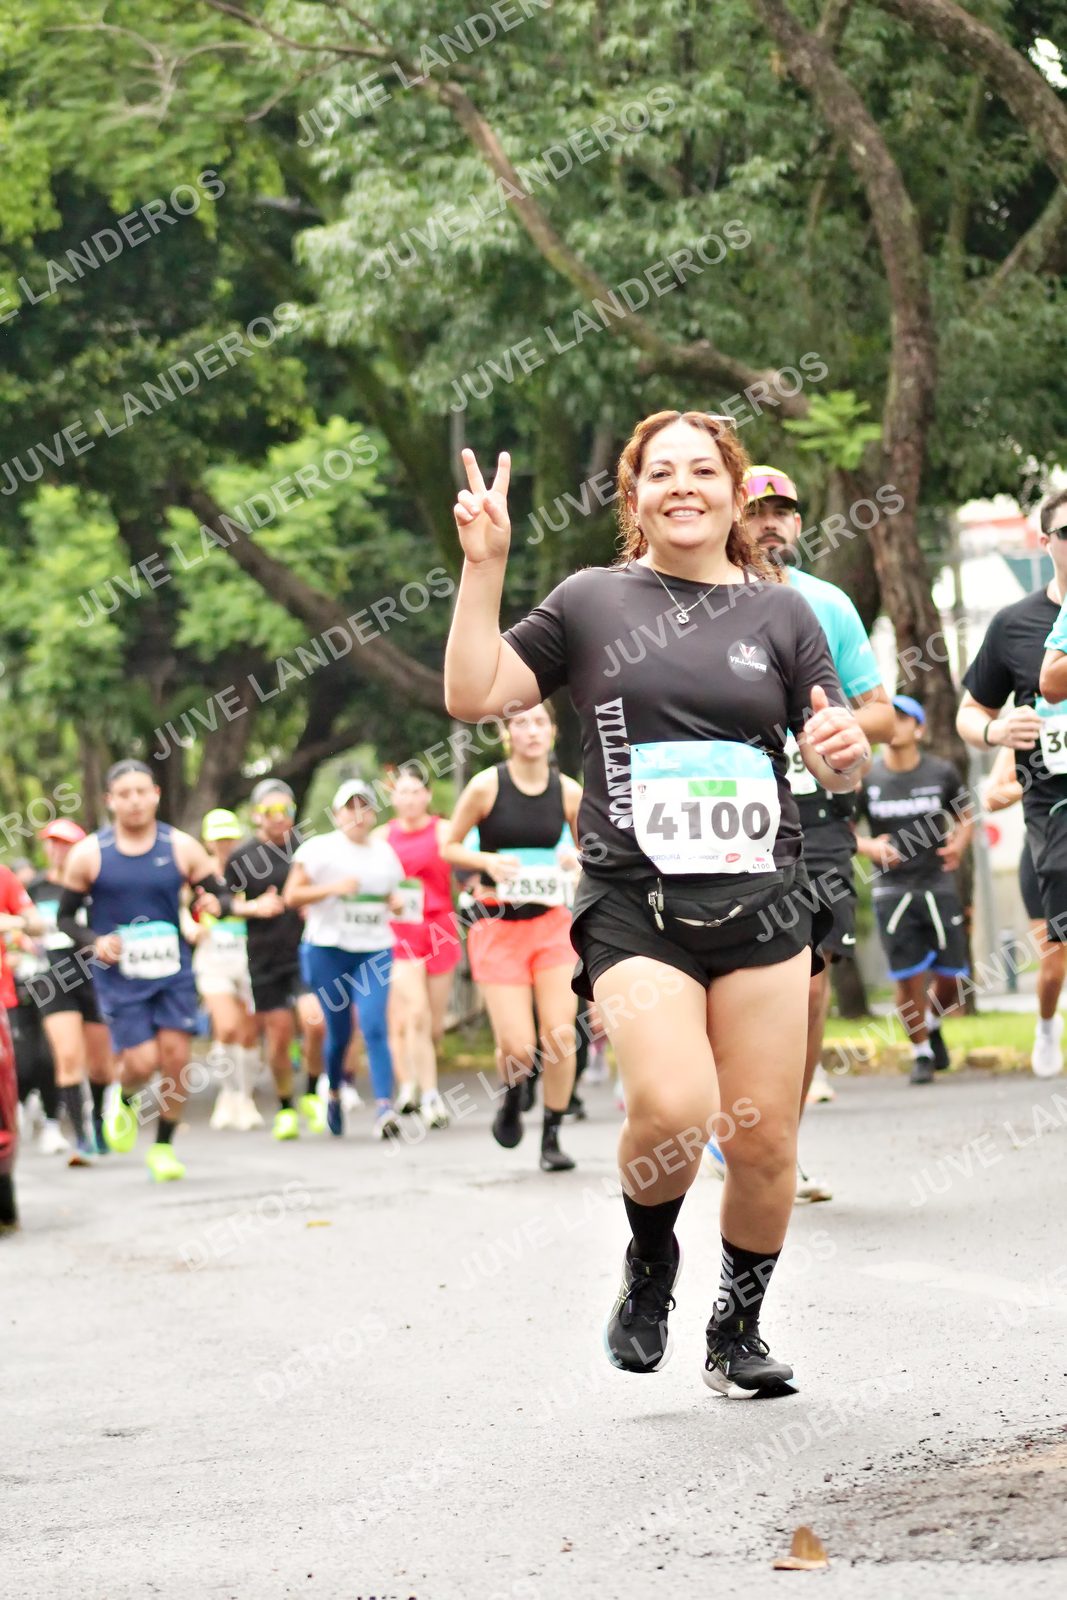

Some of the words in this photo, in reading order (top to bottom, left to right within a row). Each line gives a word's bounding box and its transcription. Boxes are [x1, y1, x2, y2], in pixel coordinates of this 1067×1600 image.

[1047, 731, 1067, 753] 3
[595, 697, 634, 829] VILLANOS
[646, 801, 771, 841] 4100
